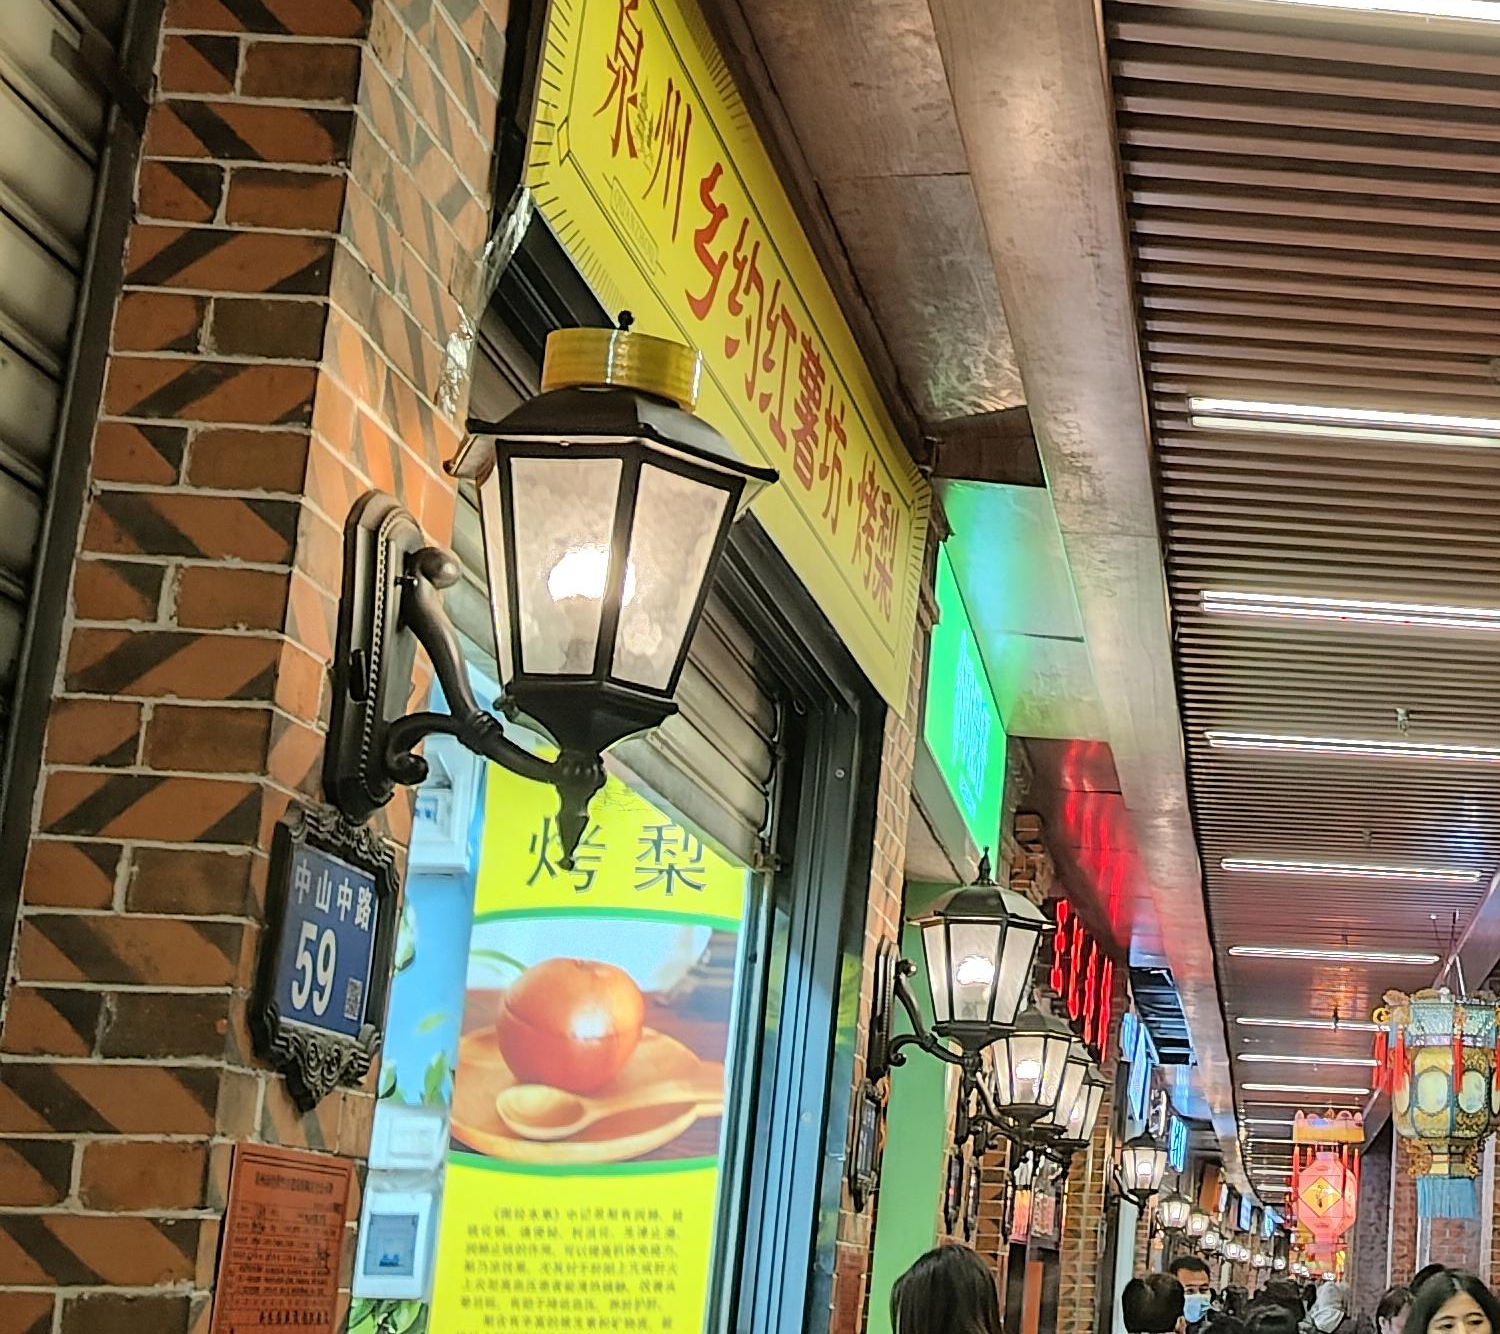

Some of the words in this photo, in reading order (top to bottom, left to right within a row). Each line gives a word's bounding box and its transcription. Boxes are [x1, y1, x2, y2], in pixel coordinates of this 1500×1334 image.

[294, 858, 373, 931] 中山中路
[291, 918, 337, 1017] 59
